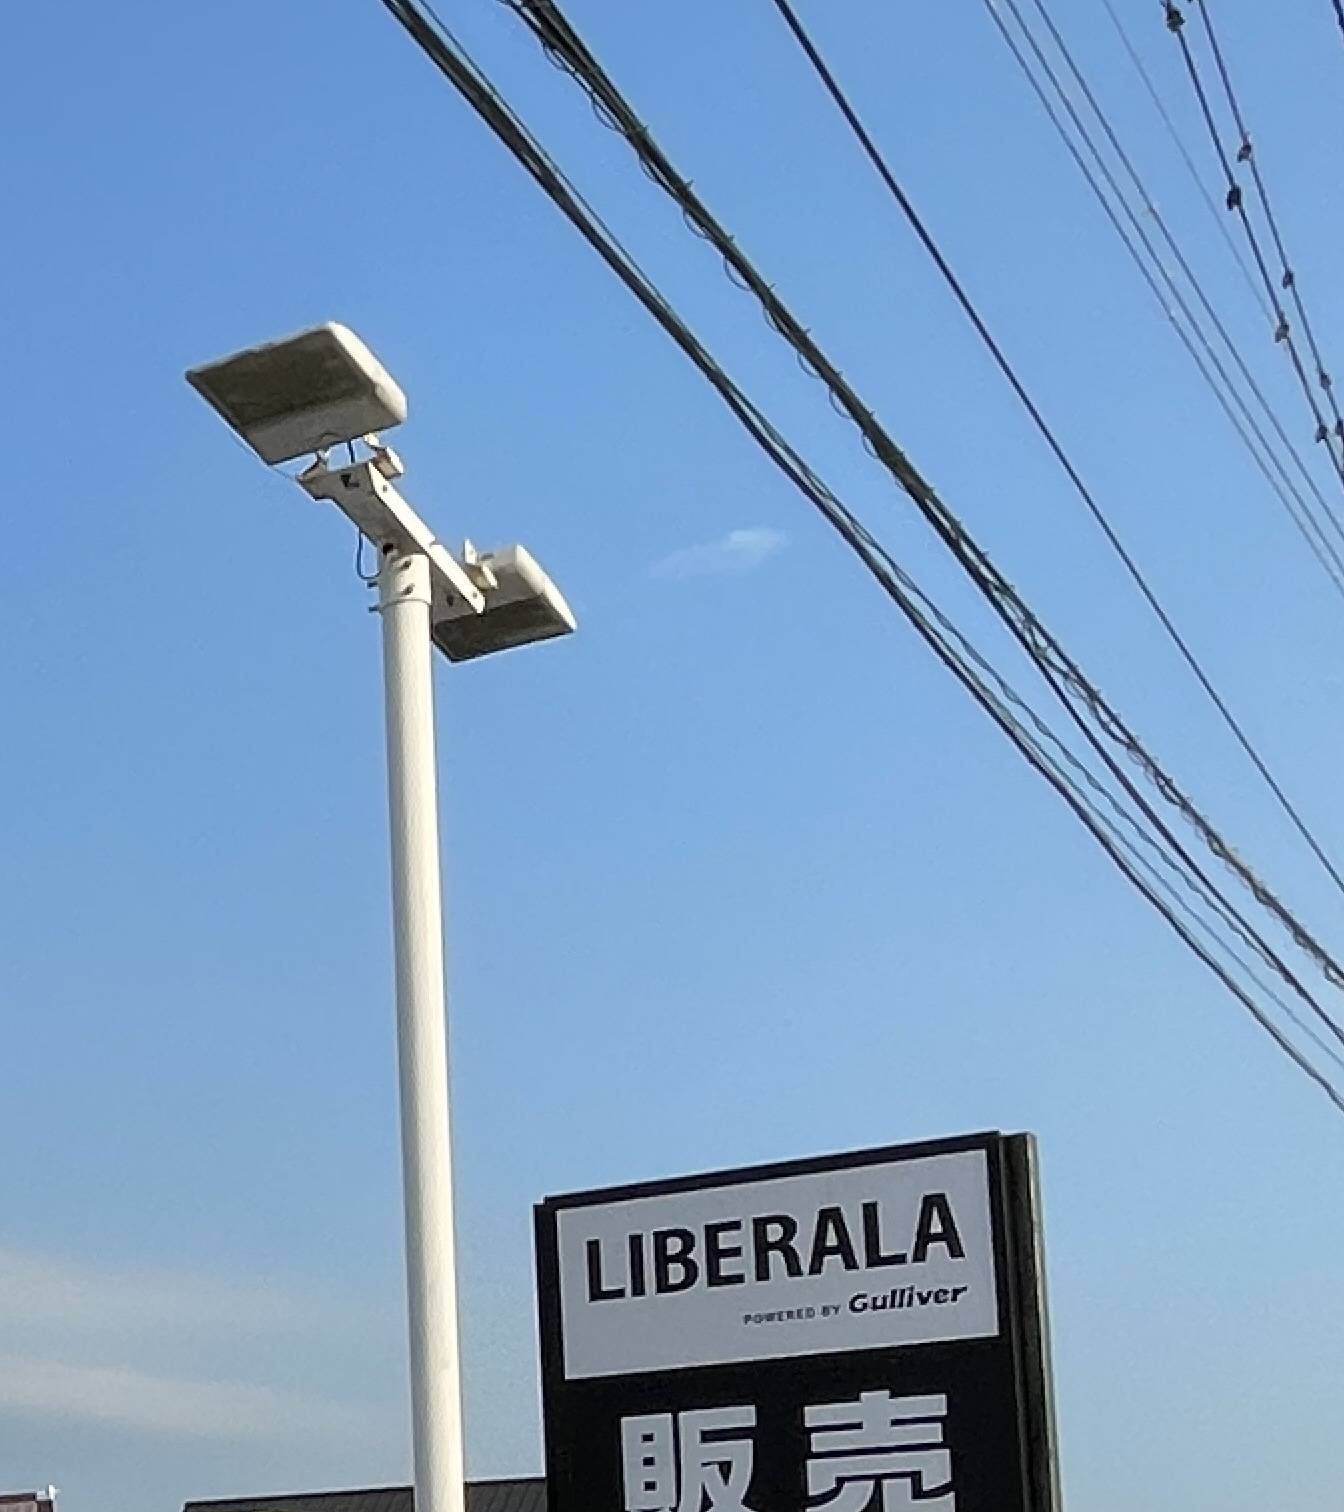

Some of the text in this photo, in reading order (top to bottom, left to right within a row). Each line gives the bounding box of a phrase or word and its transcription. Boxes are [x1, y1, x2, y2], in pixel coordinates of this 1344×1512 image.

[586, 1193, 966, 1302] LIBERALA
[743, 1284, 968, 1325] POWERED BY Gulliver
